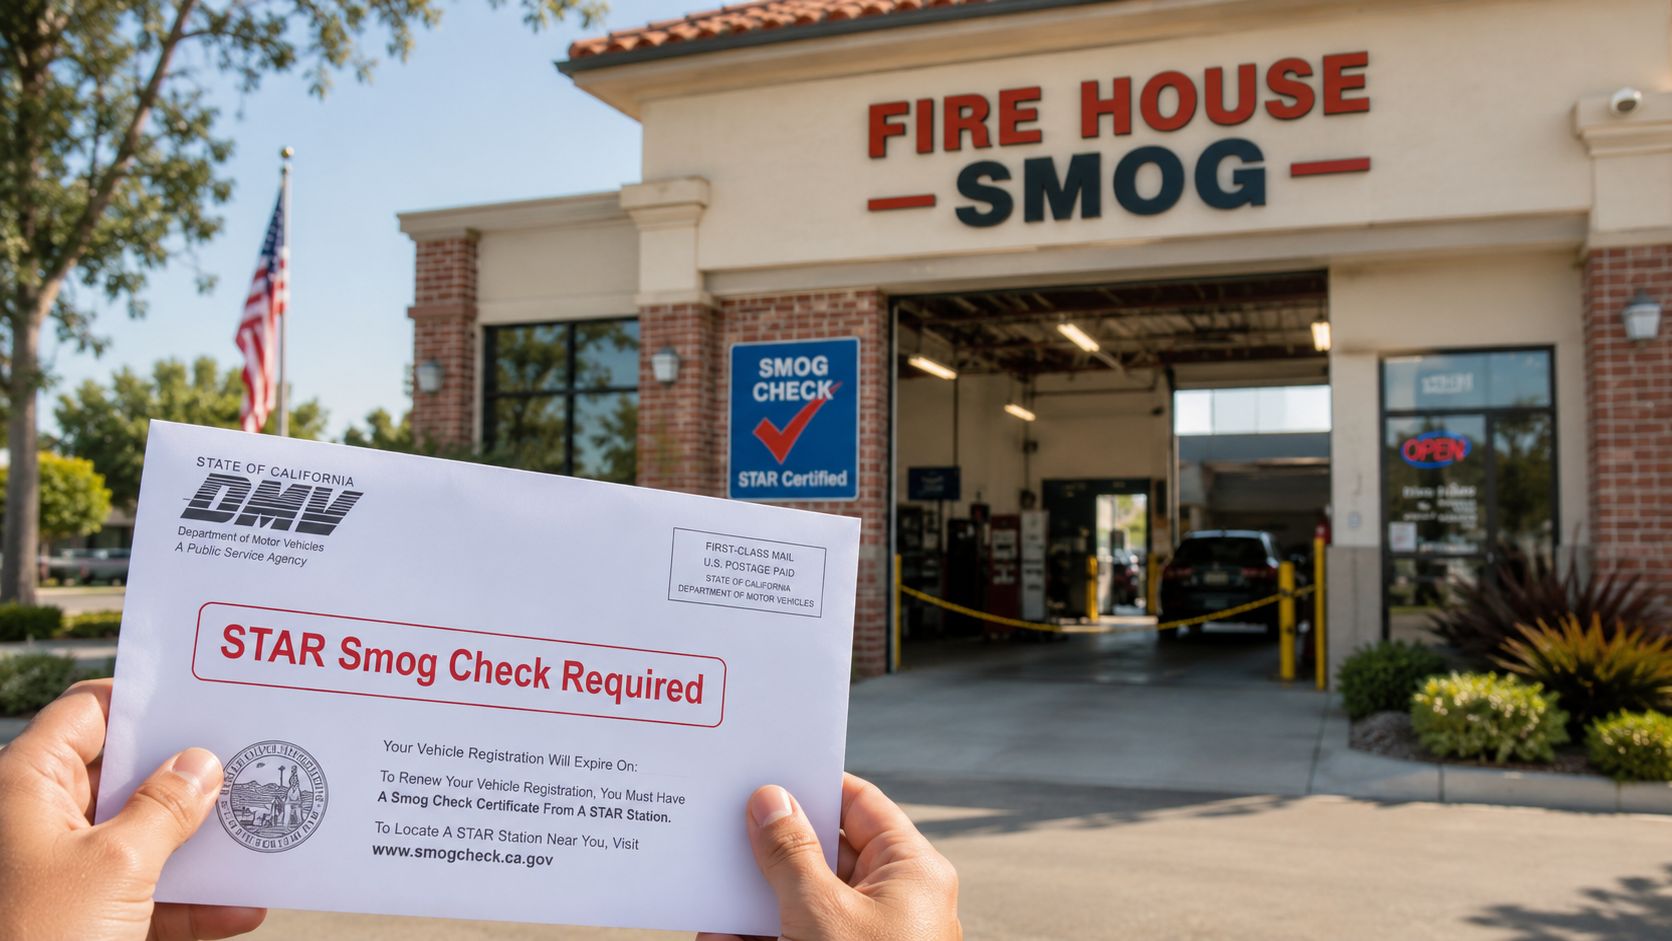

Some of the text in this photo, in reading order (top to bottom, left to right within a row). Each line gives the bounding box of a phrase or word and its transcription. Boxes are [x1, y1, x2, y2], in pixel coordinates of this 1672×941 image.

[868, 51, 1370, 159] FIRE HOUSE
[955, 138, 1266, 228] SMOG
[759, 355, 828, 378] SMOG
[752, 380, 833, 402] CHECK
[1404, 438, 1465, 461] OPEN
[196, 456, 355, 487] STATE OF CALIFORNIA
[738, 470, 848, 488] STAR Certified
[180, 472, 364, 536] DMV
[178, 526, 324, 552] Department of Motor Vehicles
[706, 542, 794, 562] FIRST-CLASS MAIL
[174, 541, 308, 568] A Public Service Agency
[704, 557, 795, 577] U.S. POSTAGE PAID
[678, 584, 814, 608] DEPARTMENT OF MOTOR VEHICLES
[706, 574, 791, 592] STATE OF CALIFORNIA
[221, 624, 704, 705] STAR Smog Check Required
[383, 740, 638, 772] Your Vehicle Registration Will Expire On:
[380, 770, 685, 805] To Renew Your Vehicle Registration, You Must Have
[377, 791, 671, 823] A Smog Check Certificate From A STAR Station.
[375, 821, 639, 850] To Locate A STAR Station Near You, Visit
[372, 845, 553, 868] www.smogcheck.ca.gov
